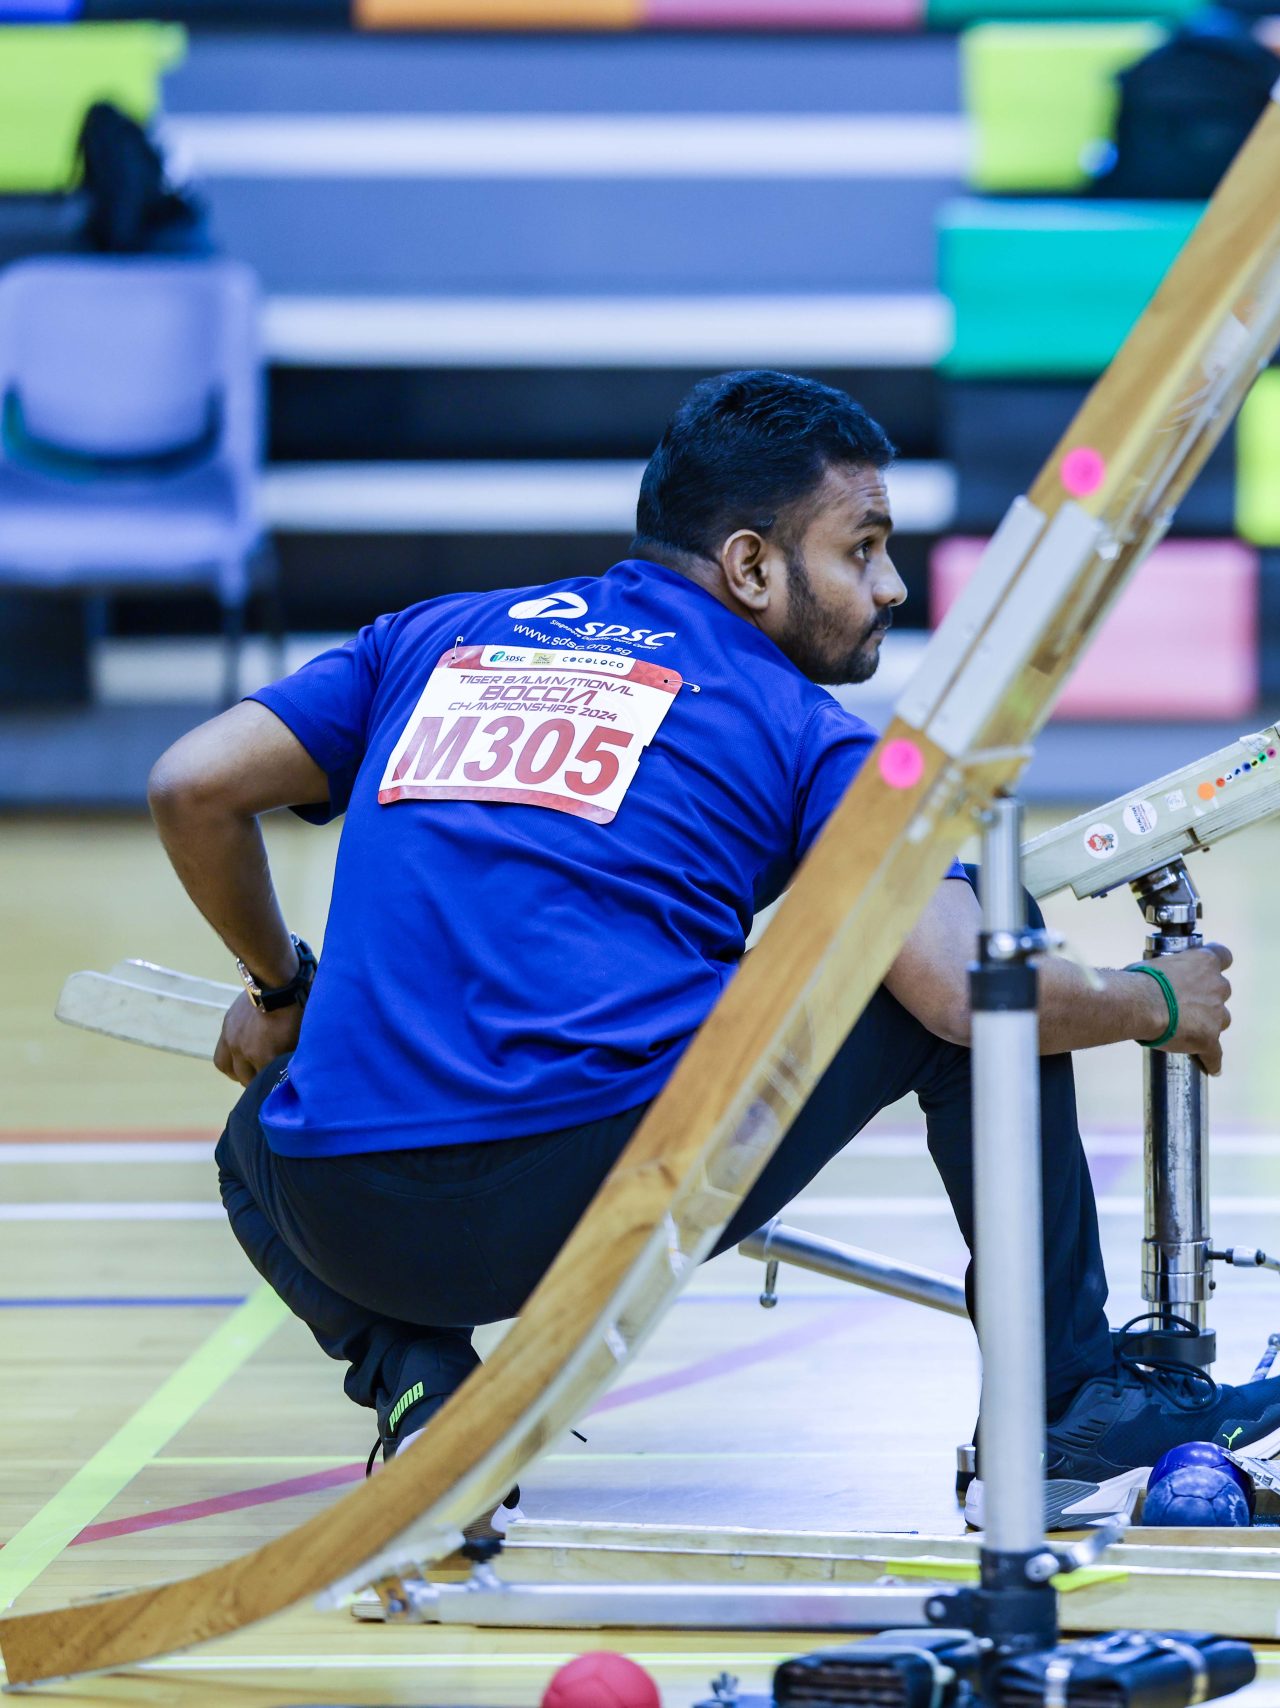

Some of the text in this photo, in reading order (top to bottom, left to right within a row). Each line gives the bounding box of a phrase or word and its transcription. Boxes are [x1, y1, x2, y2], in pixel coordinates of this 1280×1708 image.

[513, 623, 632, 656] www.sdscorg.sg
[575, 621, 677, 647] SDSC
[504, 654, 527, 663] SDSC
[562, 655, 624, 669] COCOLOCO
[459, 674, 634, 697] TIGER BALM NATIONAL
[479, 685, 599, 706] BOCCIA
[447, 702, 619, 722] CHAMPIONSHIPS 2024
[391, 715, 634, 796] M305
[388, 1380, 425, 1433] PUMA
